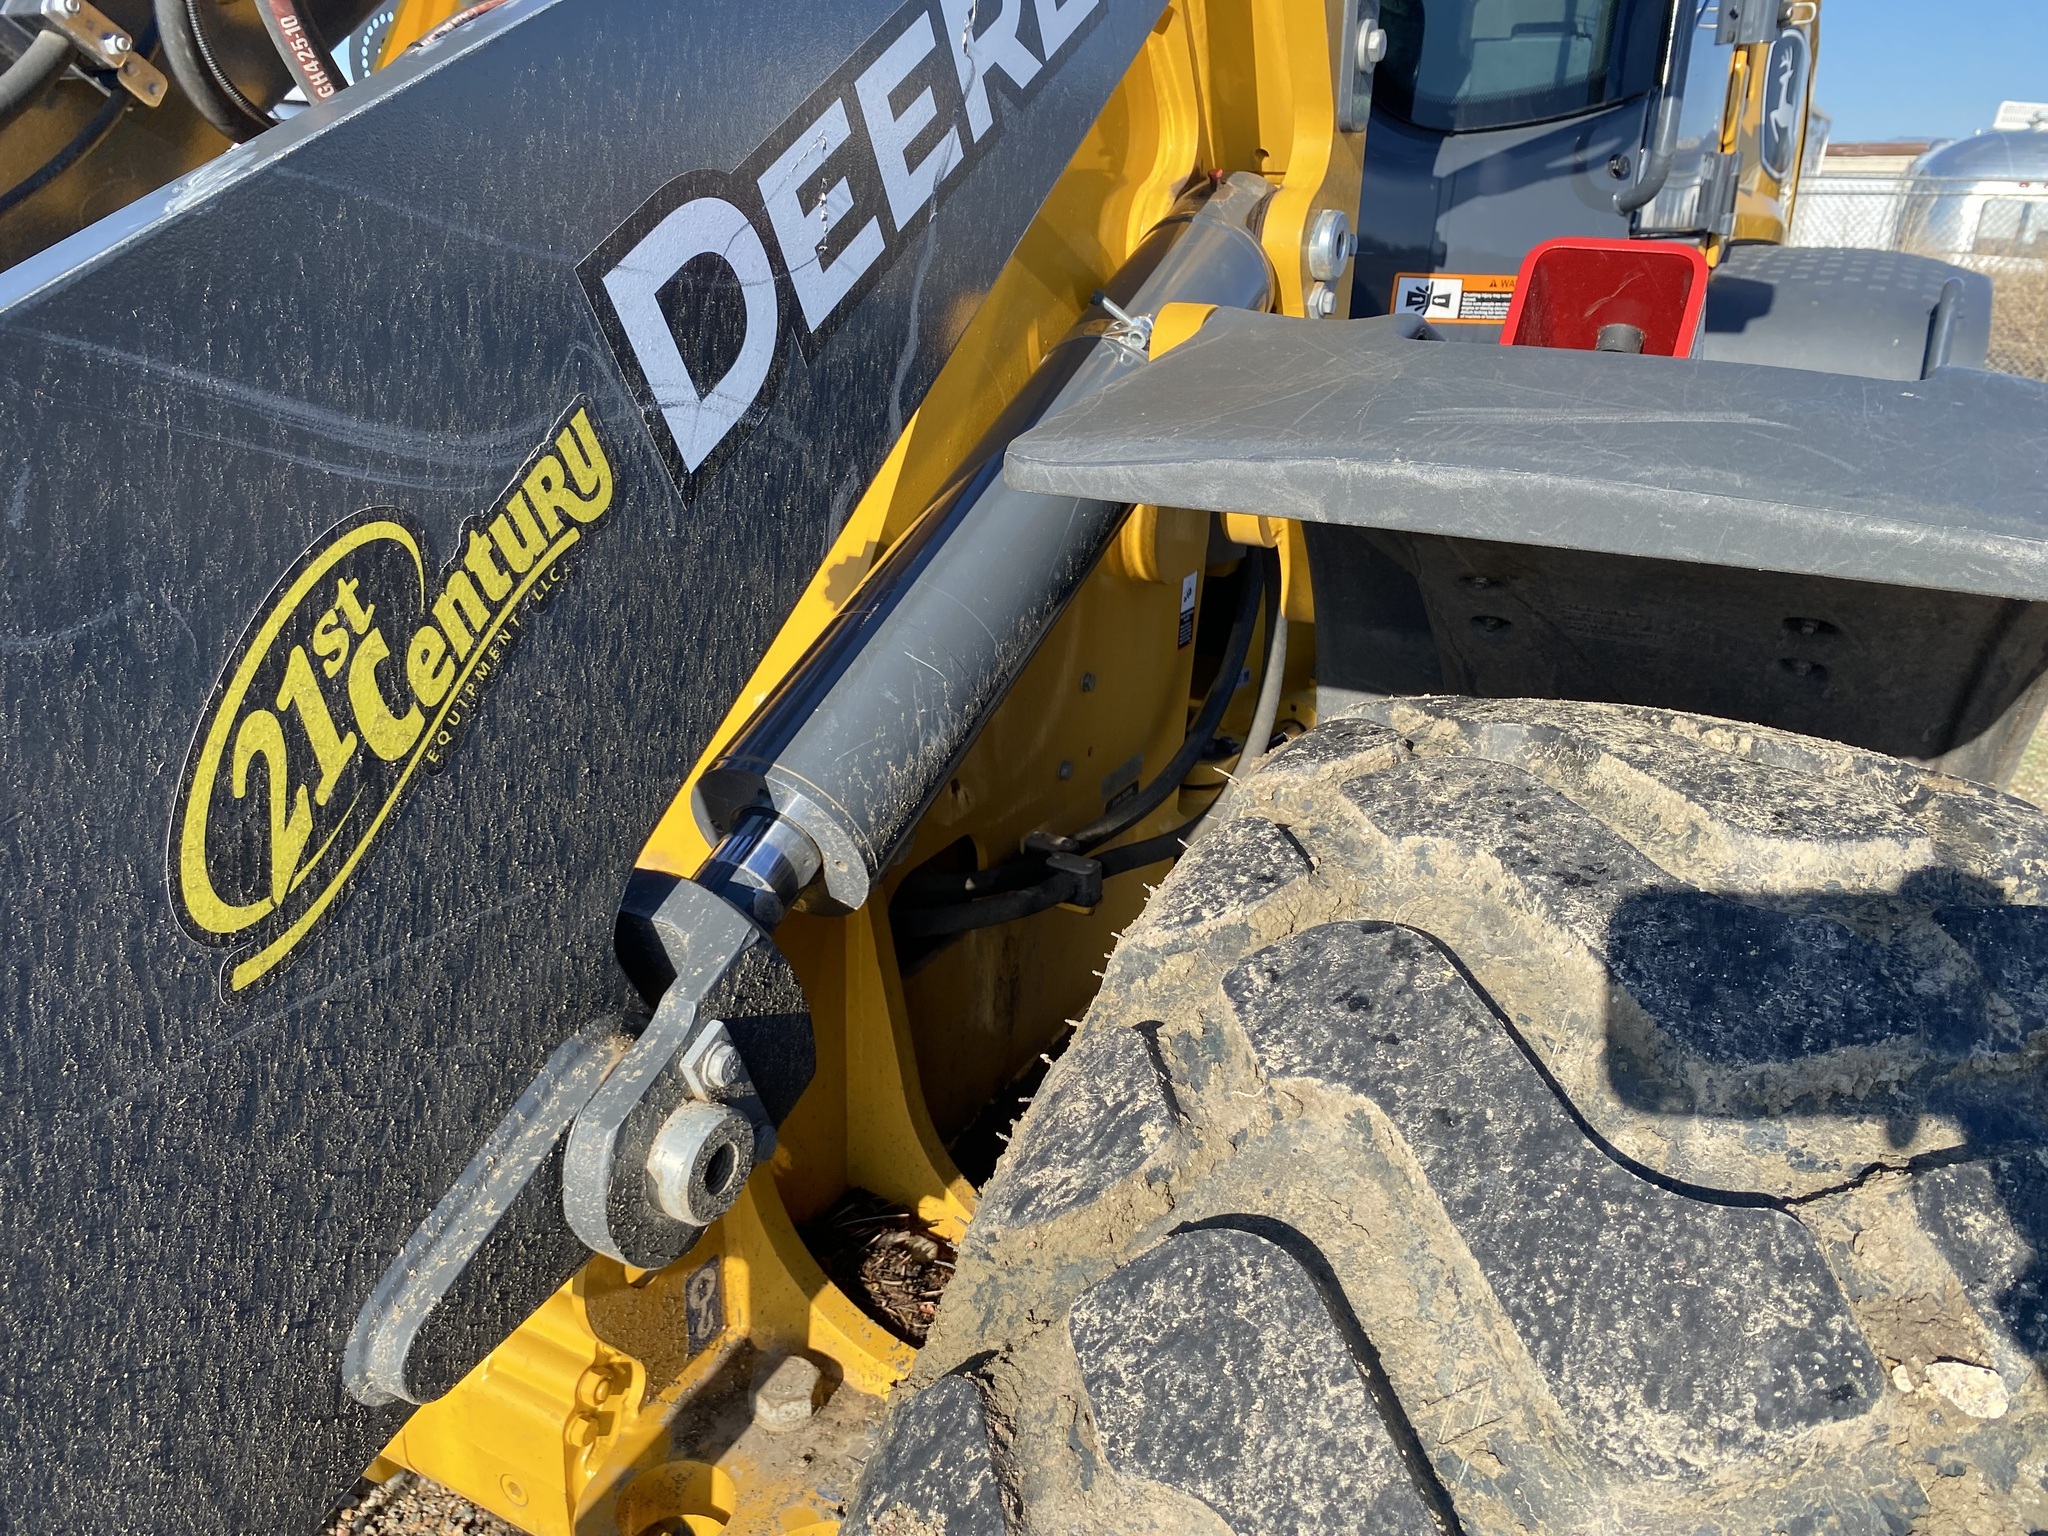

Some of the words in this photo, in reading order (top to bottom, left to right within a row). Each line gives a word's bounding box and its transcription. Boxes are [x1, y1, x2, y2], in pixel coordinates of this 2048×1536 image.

[280, 14, 335, 98] GH425-10
[232, 576, 374, 906] 21st
[427, 615, 522, 765] EQUIPMENT
